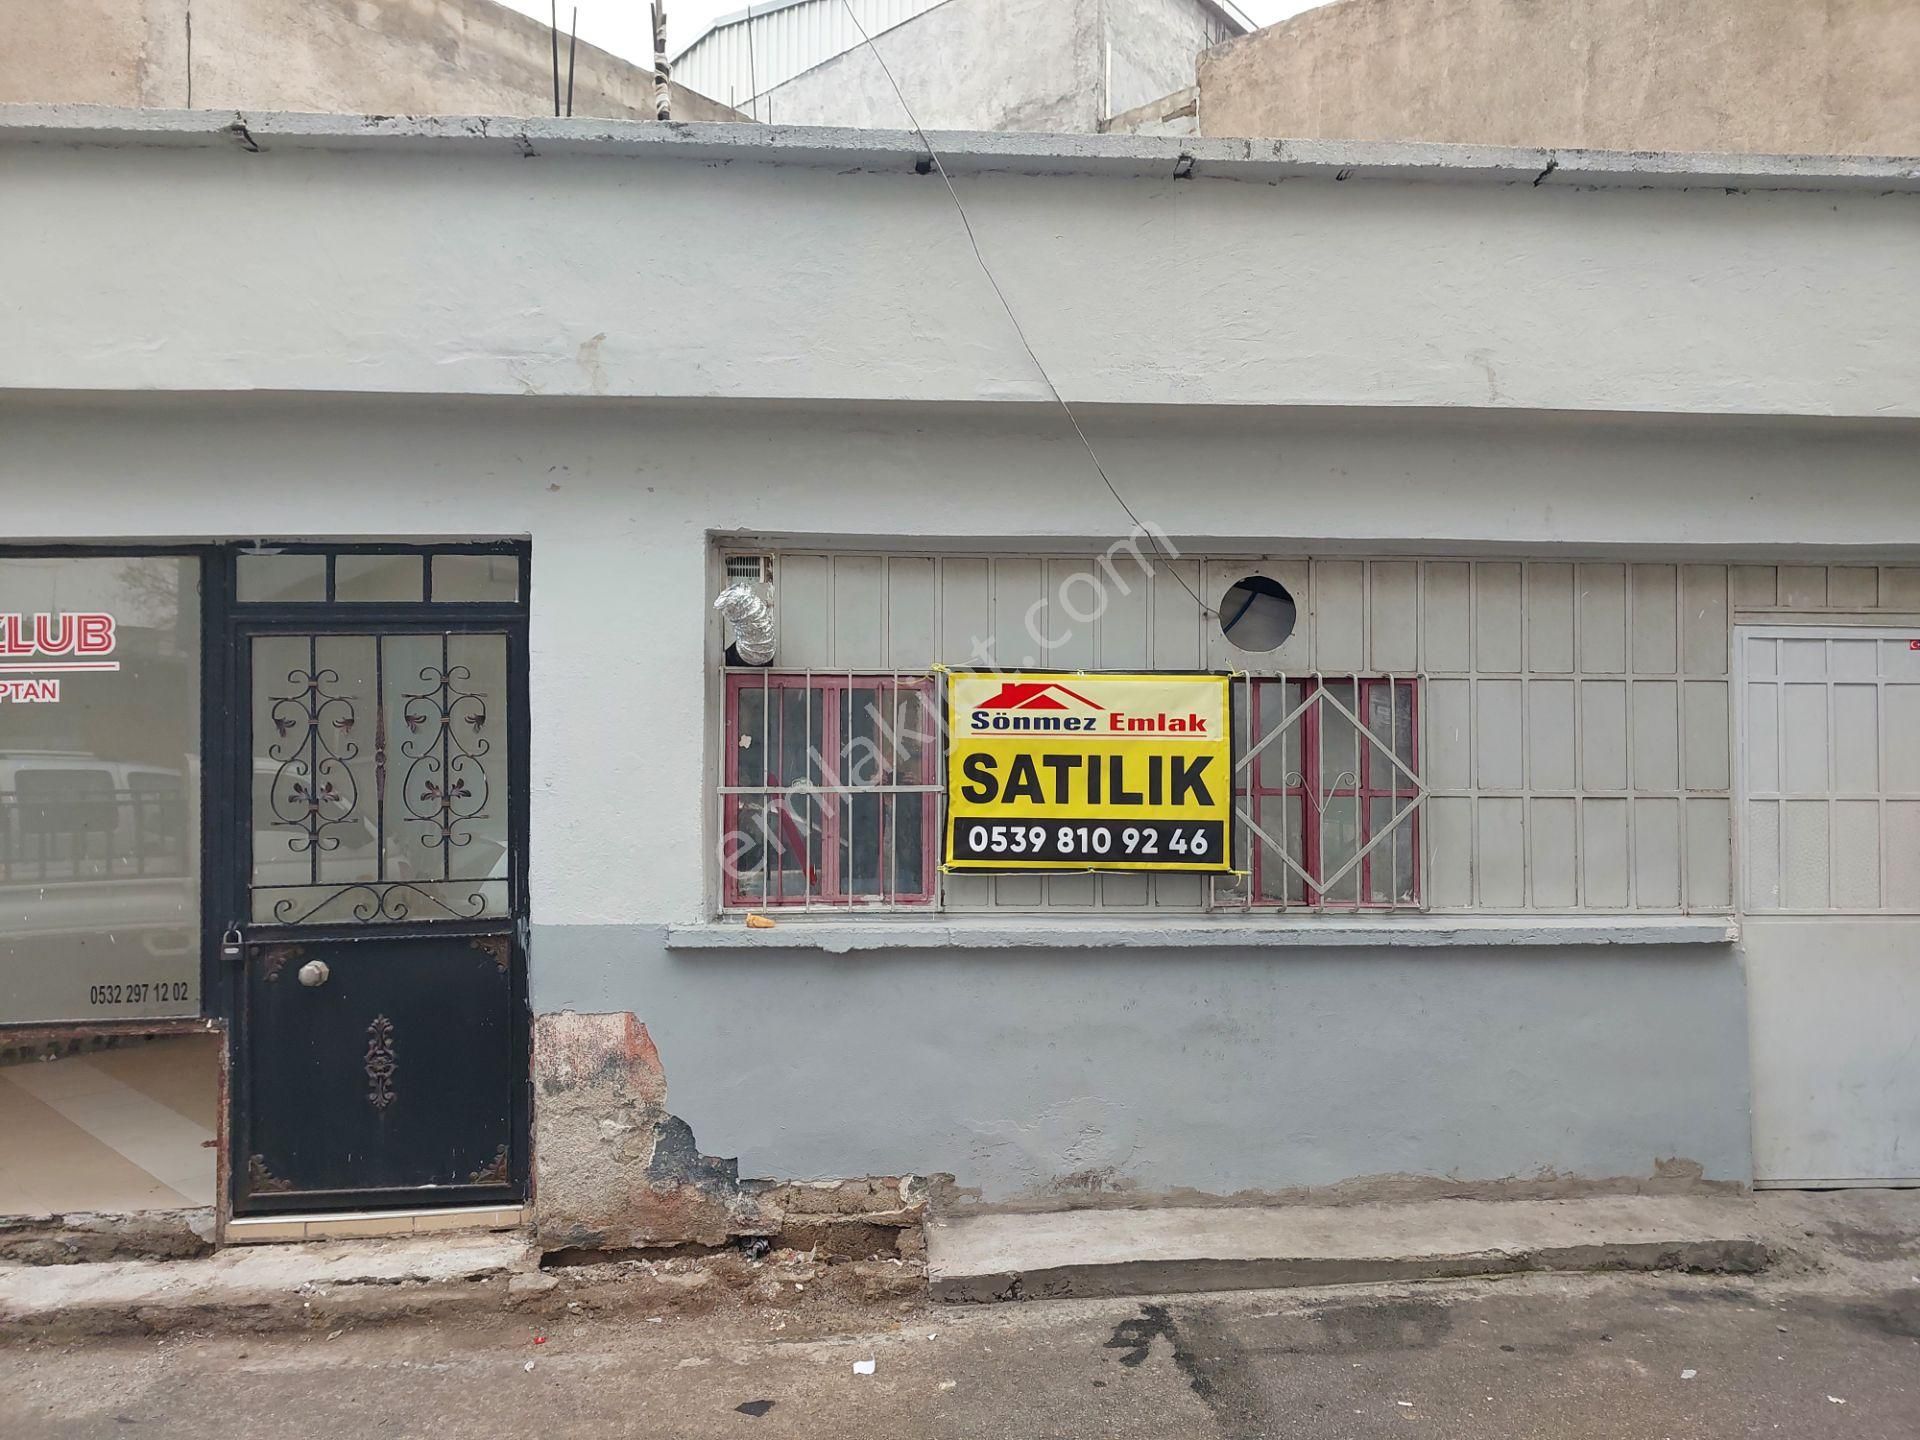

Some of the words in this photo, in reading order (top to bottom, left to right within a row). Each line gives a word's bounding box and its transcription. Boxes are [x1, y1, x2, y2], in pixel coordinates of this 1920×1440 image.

[0, 612, 116, 656] LUB
[971, 710, 1096, 731] Sönmez
[1109, 712, 1207, 732] Emlak
[961, 753, 1215, 806] SATILIK
[968, 825, 1046, 853] 0539
[1057, 827, 1111, 854] 810
[1122, 828, 1158, 854] 92
[1168, 828, 1208, 855] 46
[90, 984, 122, 1004] 0532
[126, 983, 149, 1003] 297
[153, 982, 168, 1001] 12
[172, 981, 188, 1001] 02
